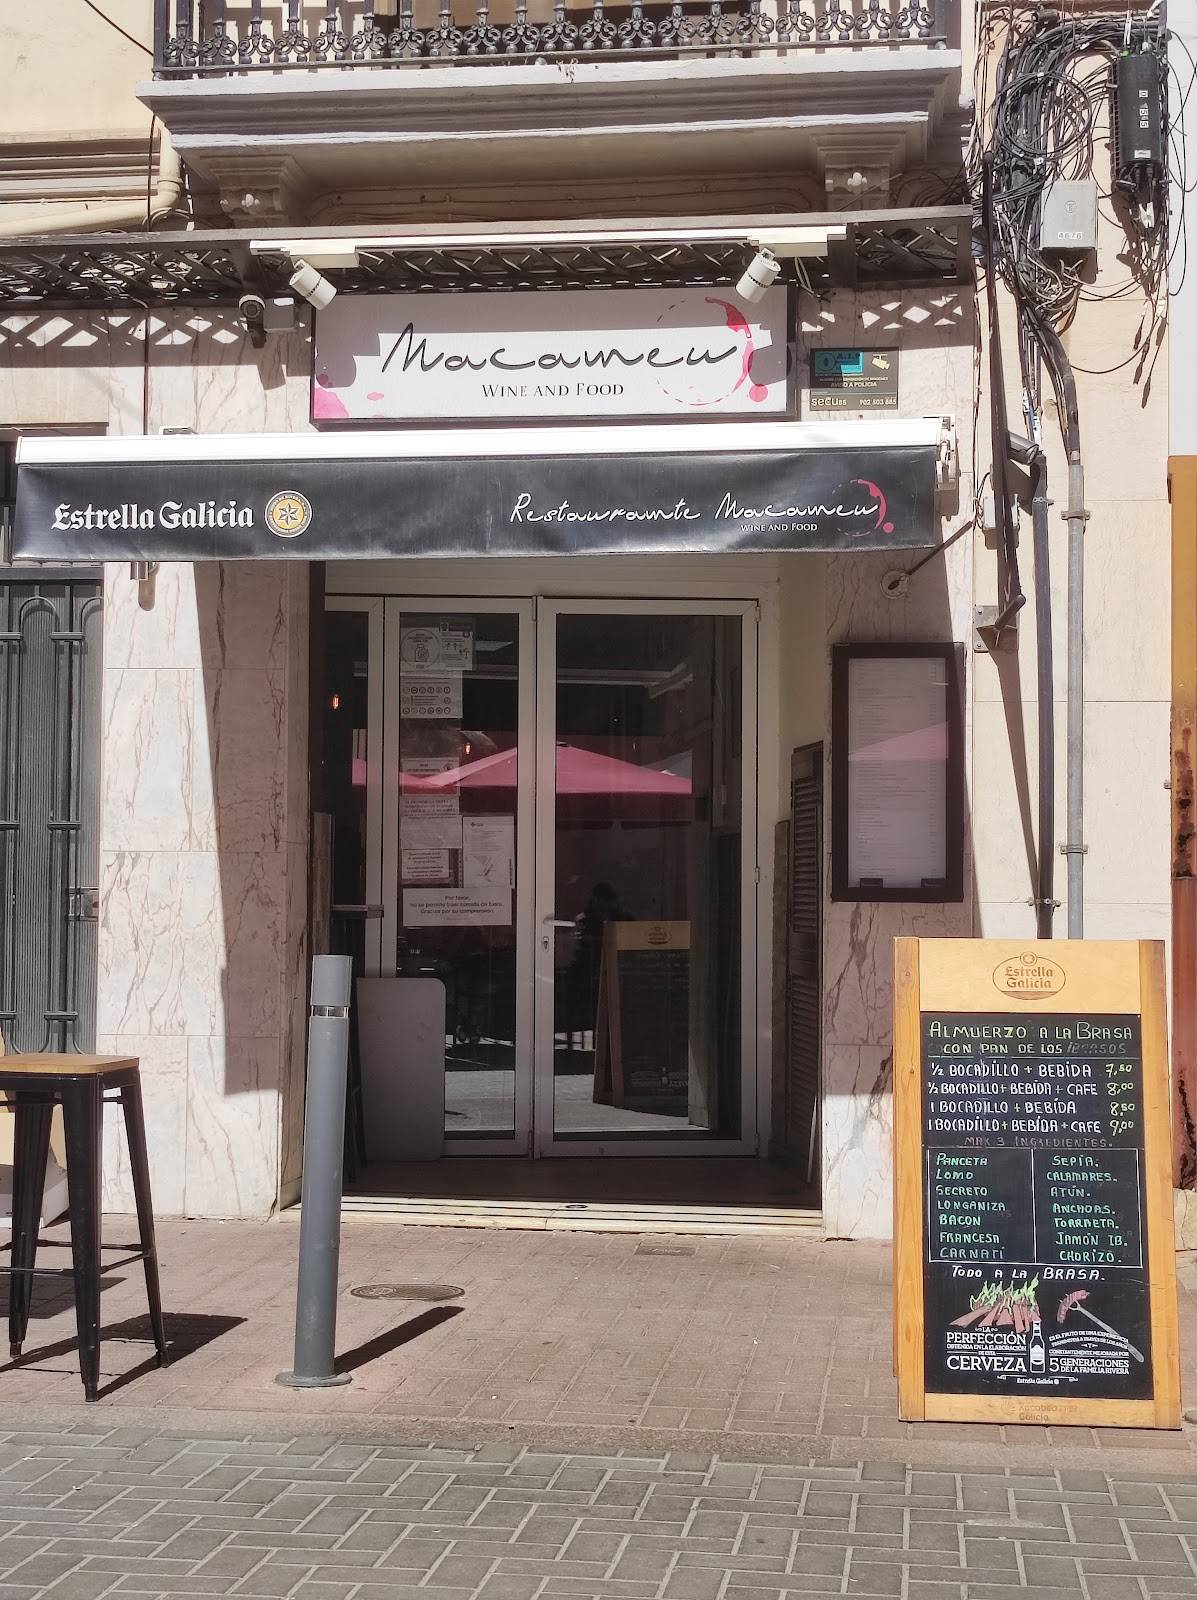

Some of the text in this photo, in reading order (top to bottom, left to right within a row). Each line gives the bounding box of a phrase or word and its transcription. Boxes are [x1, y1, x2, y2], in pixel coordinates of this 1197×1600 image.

[482, 382, 625, 398] WINE AND FOOD
[510, 493, 700, 523] Restaurante
[51, 503, 156, 530] Estrella
[159, 500, 254, 530] Galicia
[740, 522, 818, 532] WINE AND FOOD
[1005, 966, 1053, 977] Estrella
[1006, 977, 1052, 988] Galicia
[930, 1021, 1133, 1040] ALMUERZO A LA BRASA
[943, 1043, 972, 1054] CON
[980, 1043, 1008, 1054] PAN
[1018, 1044, 1034, 1053] DE
[1041, 1044, 1063, 1054] LOS
[1024, 1065, 1032, 1074] +
[1055, 1086, 1063, 1094] +
[1067, 1083, 1098, 1095] CAFE
[1014, 1104, 1021, 1112] +
[1061, 1122, 1069, 1130] +
[1071, 1121, 1101, 1133] CAFE
[997, 1137, 1004, 1146] 3
[936, 1152, 988, 1166] PANCETA
[936, 1169, 974, 1180] LOMO
[936, 1186, 988, 1196] SECRETO
[937, 1200, 1006, 1212] LONGANIZA
[940, 1214, 981, 1226] BACON
[940, 1232, 1000, 1244] FRANCESA
[952, 1265, 983, 1278] TODO
[995, 1268, 1003, 1278] A
[1012, 1268, 1028, 1278] LA
[946, 1331, 1026, 1345] PERFECCIÓN
[947, 1356, 1027, 1372] CERVEZA
[1050, 1358, 1129, 1372] 5 GENERACIONES
[1019, 1413, 1049, 1421] Galicia
